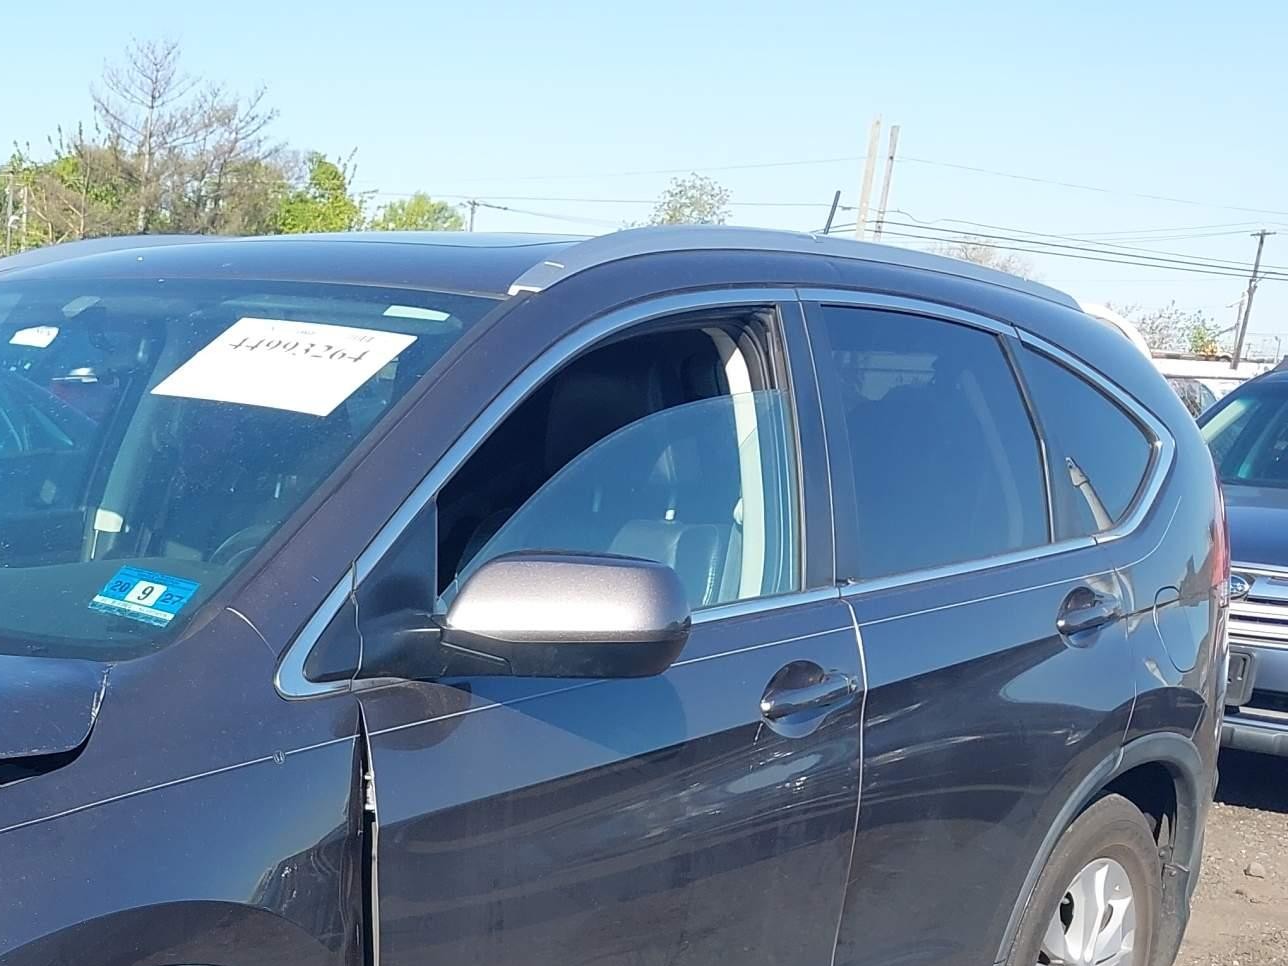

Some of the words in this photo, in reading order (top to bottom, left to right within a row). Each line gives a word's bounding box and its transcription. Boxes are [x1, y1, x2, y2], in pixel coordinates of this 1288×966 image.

[110, 580, 131, 593] 20
[137, 585, 155, 601] 9
[161, 593, 185, 605] 27
